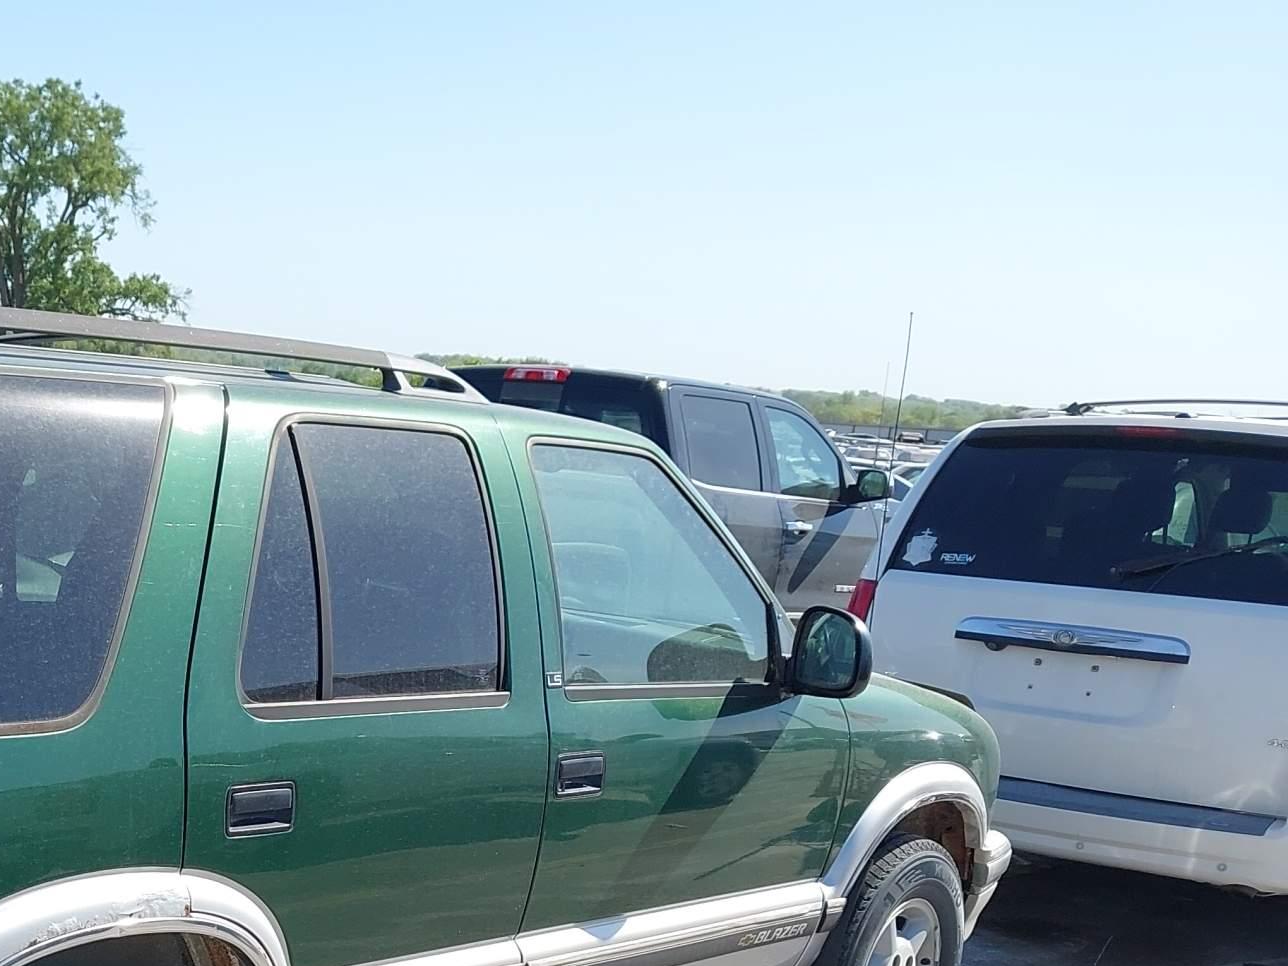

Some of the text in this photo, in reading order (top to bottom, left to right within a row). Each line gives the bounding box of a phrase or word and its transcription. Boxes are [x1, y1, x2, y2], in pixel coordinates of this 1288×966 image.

[940, 552, 976, 562] RENEW
[547, 674, 562, 686] LS
[754, 922, 808, 945] BLAZER
